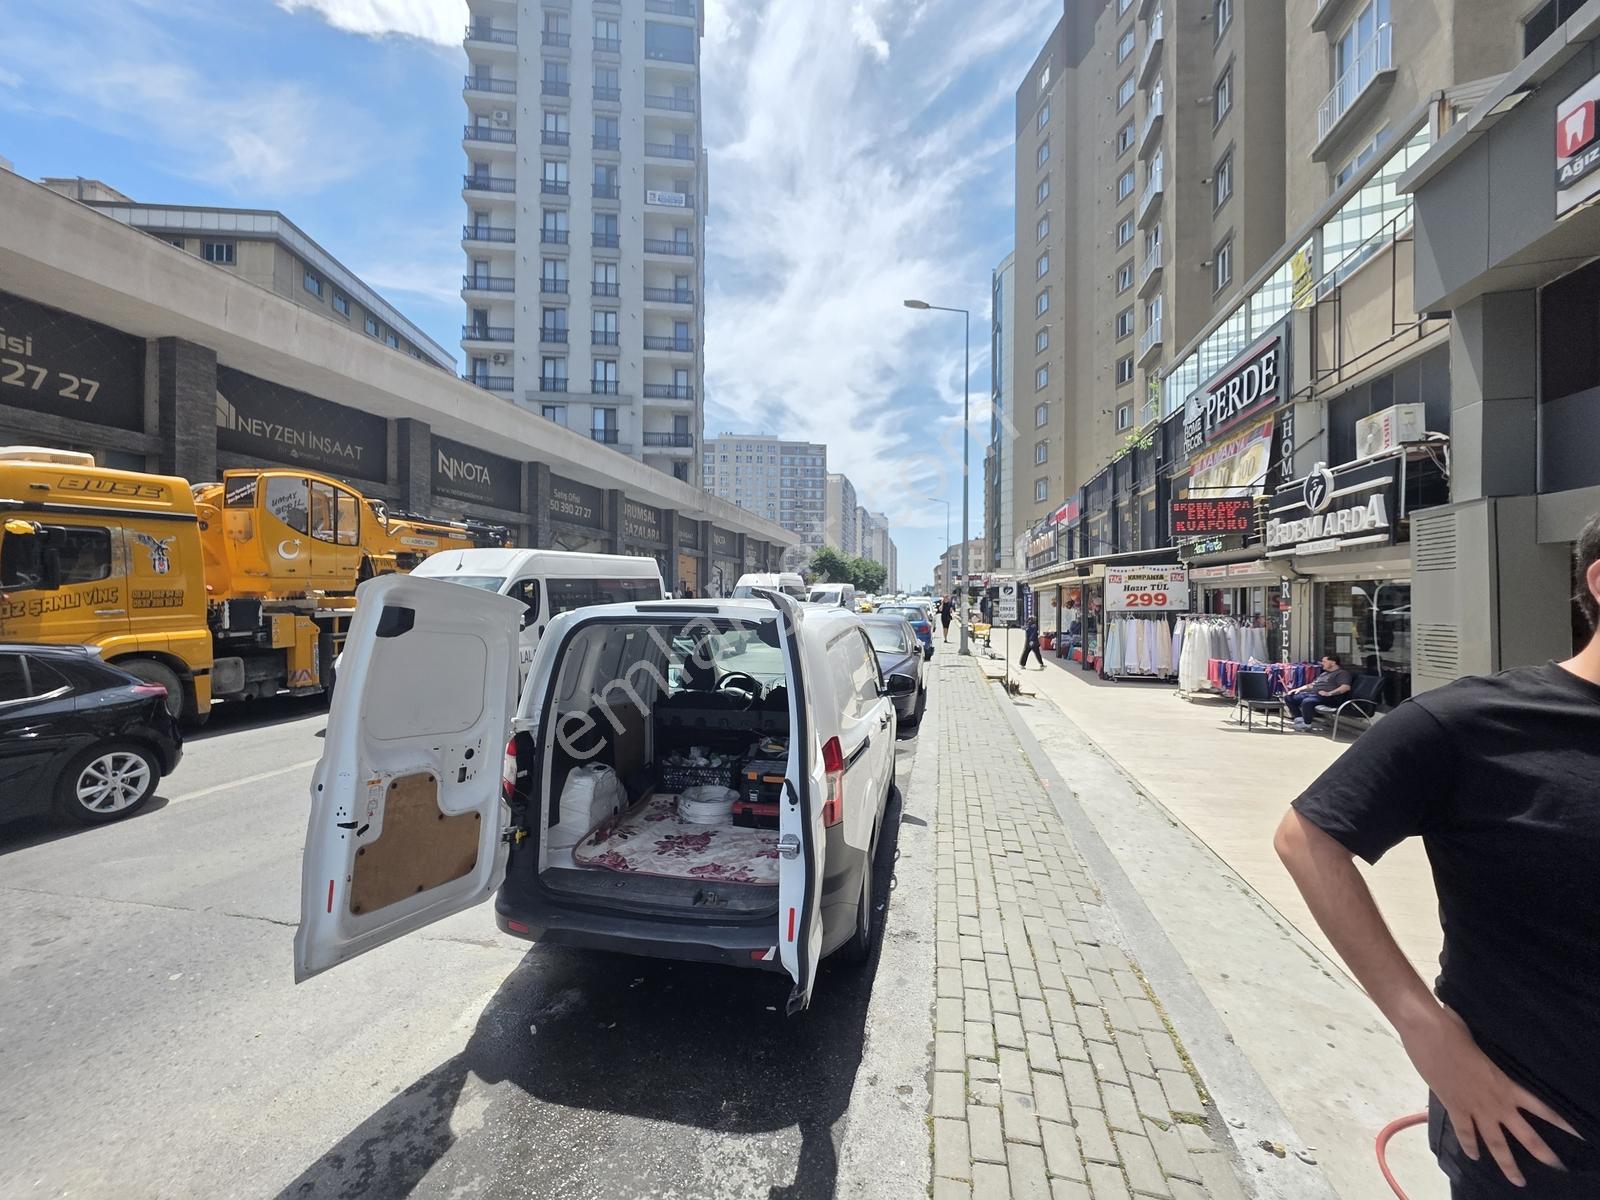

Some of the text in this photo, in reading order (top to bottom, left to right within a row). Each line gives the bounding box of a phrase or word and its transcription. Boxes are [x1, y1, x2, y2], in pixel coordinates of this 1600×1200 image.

[1, 358, 100, 402] 27 27
[1206, 350, 1277, 431] PERDE
[238, 415, 306, 448] NEYZEN
[1281, 418, 1293, 483] HOM
[454, 460, 491, 486] NOTA
[1266, 515, 1325, 547] ERDEM
[1322, 493, 1390, 537] ARDA
[28, 592, 81, 618] ŞANLI
[1125, 592, 1167, 607] 299
